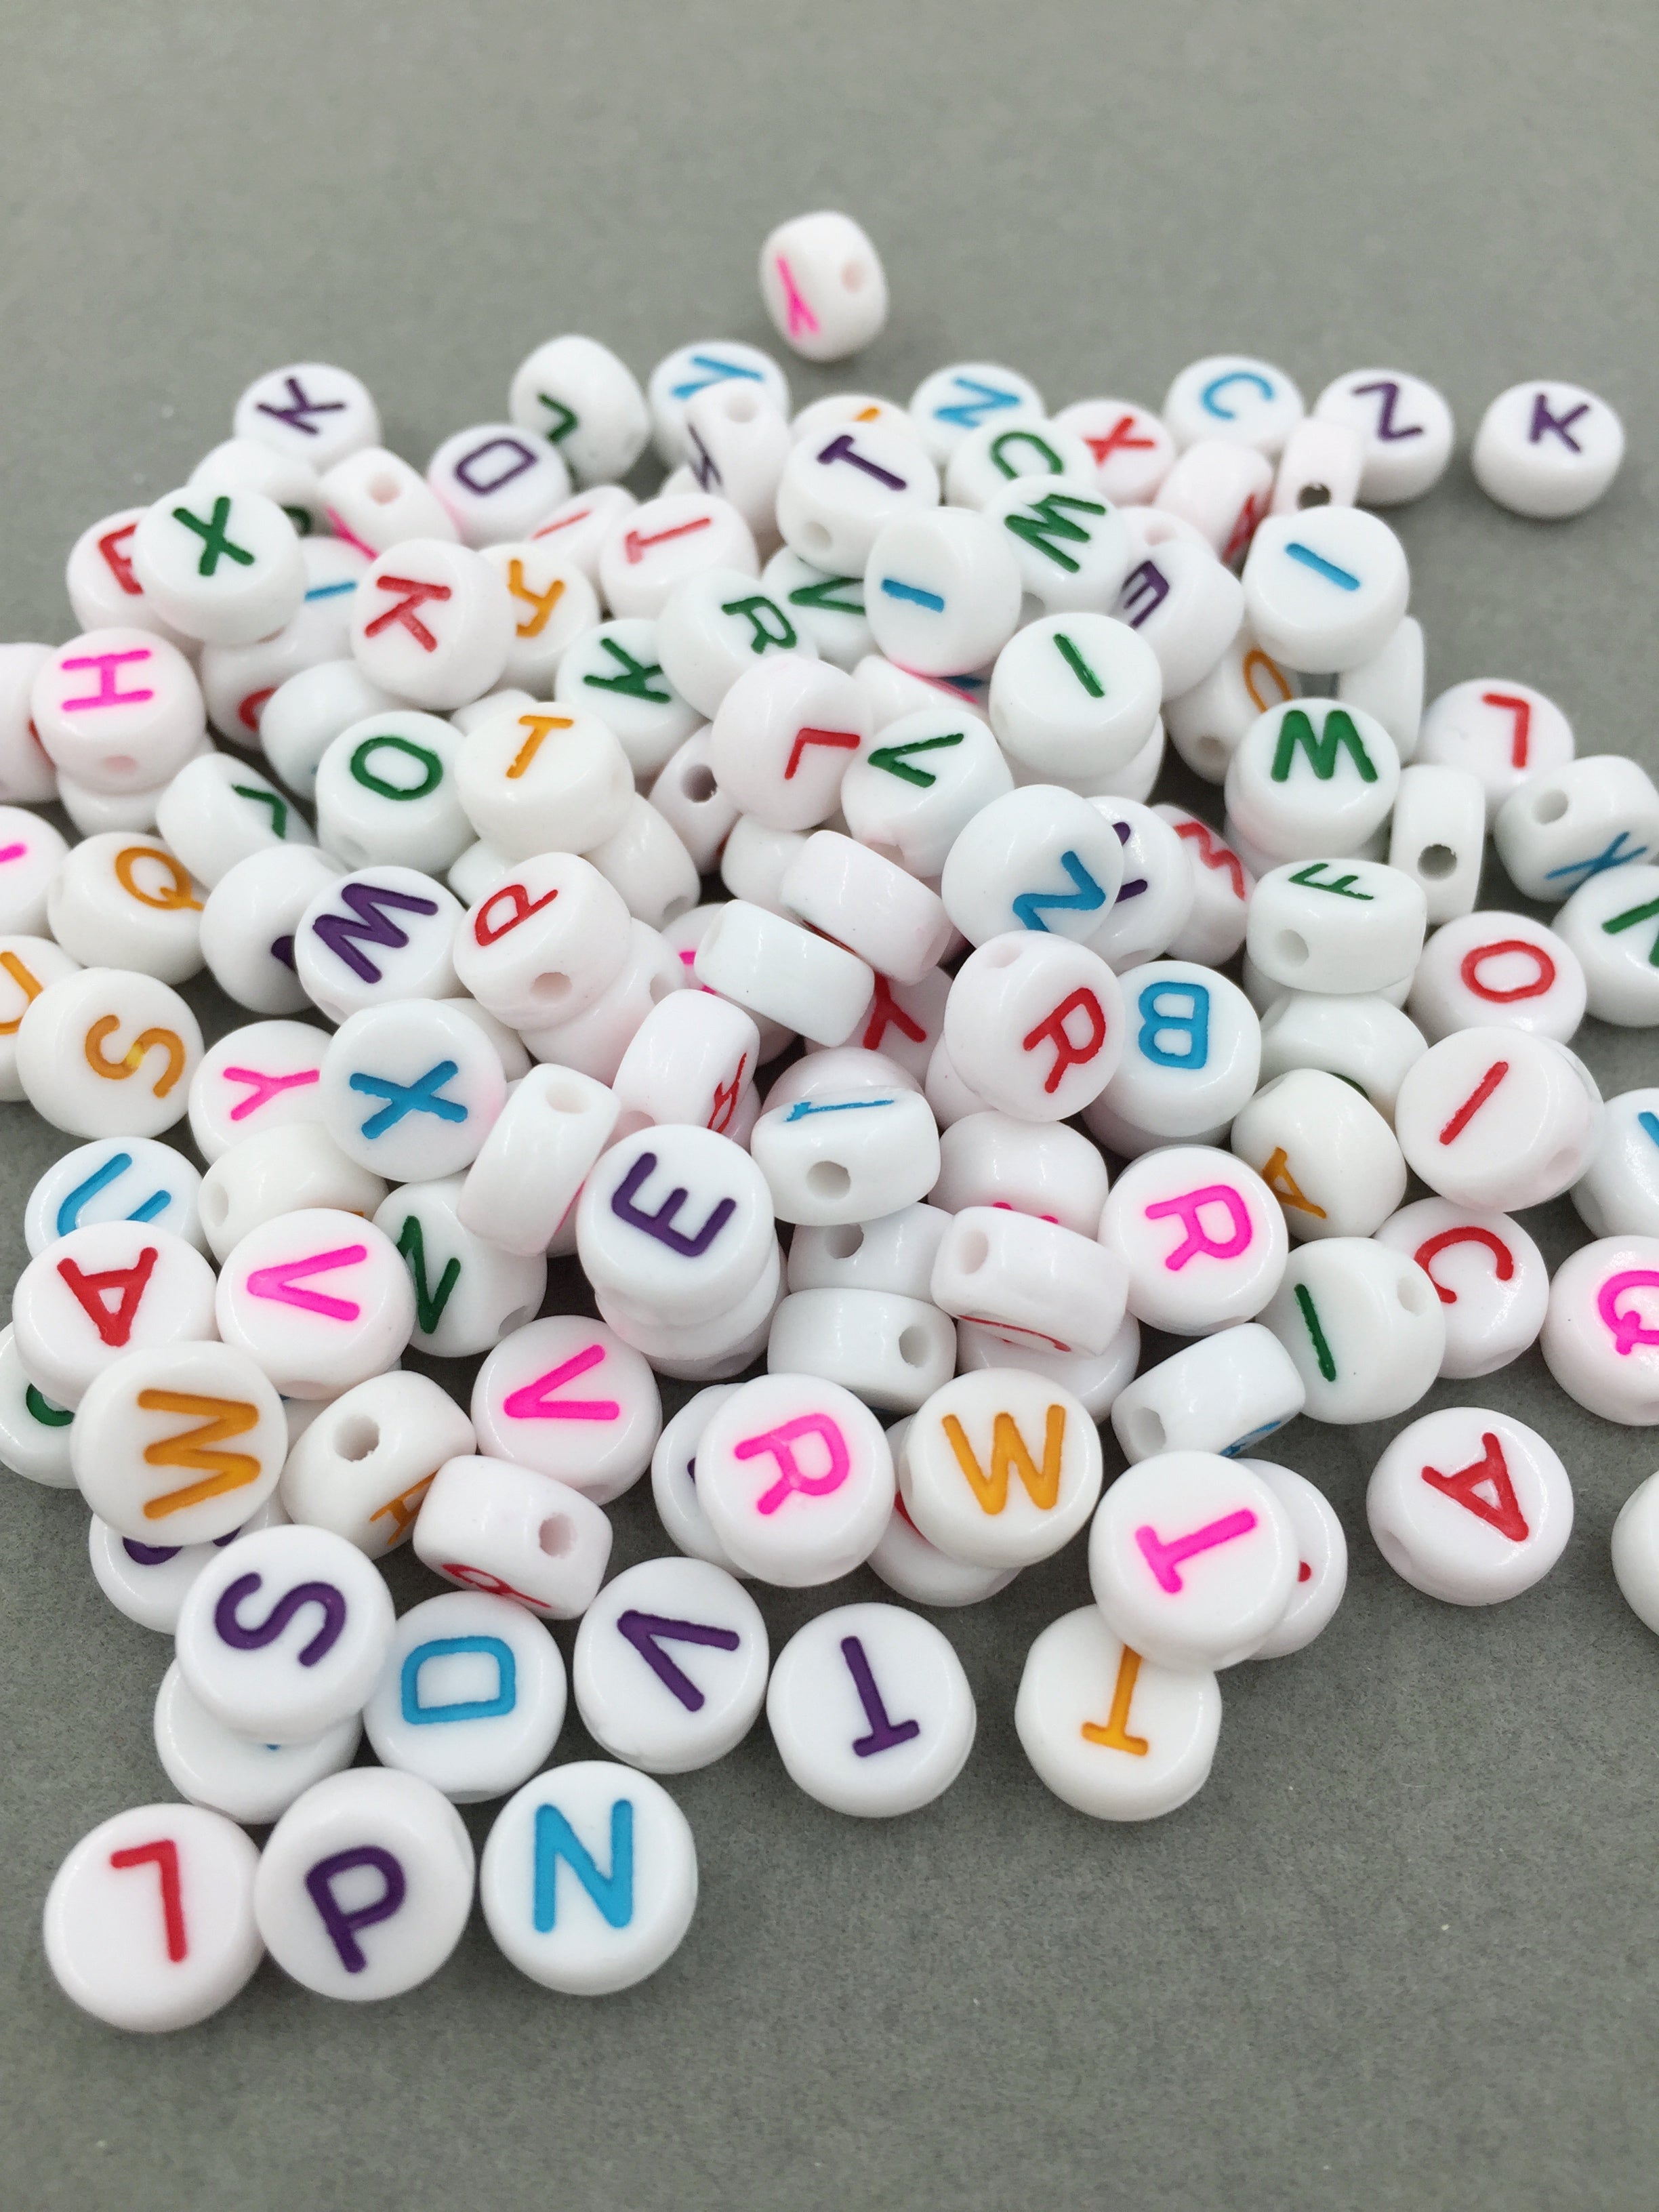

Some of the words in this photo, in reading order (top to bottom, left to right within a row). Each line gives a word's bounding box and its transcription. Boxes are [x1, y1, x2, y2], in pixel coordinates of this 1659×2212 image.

[775, 253, 821, 337] Y
[254, 375, 348, 435] K
[1201, 371, 1275, 421] C
[1528, 392, 1590, 455] K
[817, 434, 907, 491] T
[172, 495, 256, 577] X
[624, 514, 714, 565] T
[1284, 541, 1361, 593] I
[363, 573, 453, 653] K
[720, 596, 798, 655] R
[880, 577, 946, 613] I
[1120, 559, 1171, 628] E
[60, 647, 156, 713] H
[581, 636, 672, 705] K
[1052, 631, 1112, 699] I
[348, 735, 445, 802] O
[504, 713, 575, 780] T
[783, 726, 861, 781] L
[865, 731, 965, 790] V
[1482, 691, 1532, 771] L
[114, 845, 205, 912] Q
[474, 882, 560, 947] P
[1287, 861, 1376, 901] F
[1460, 939, 1557, 1005] O
[84, 1013, 187, 1099] S
[1022, 986, 1108, 1094] R
[1137, 979, 1212, 1071] B
[222, 1065, 321, 1123] Y
[348, 1059, 469, 1141] X
[1438, 1060, 1510, 1147] I
[611, 1151, 737, 1258] E
[1143, 1182, 1255, 1273] R
[56, 1246, 159, 1349] A
[245, 1243, 369, 1324] V
[1413, 1225, 1516, 1305] C
[1293, 1283, 1338, 1383] I
[501, 1343, 621, 1423] V
[732, 1411, 853, 1518] R
[941, 1402, 1067, 1517] W
[1420, 1431, 1532, 1543] A
[1133, 1506, 1261, 1597] T
[213, 1571, 348, 1668] S
[400, 1634, 518, 1727] D
[617, 1609, 740, 1713] V
[840, 1635, 922, 1759] T
[108, 1838, 188, 1965] L
[532, 1798, 636, 1935] N
[305, 1845, 408, 1975] P
